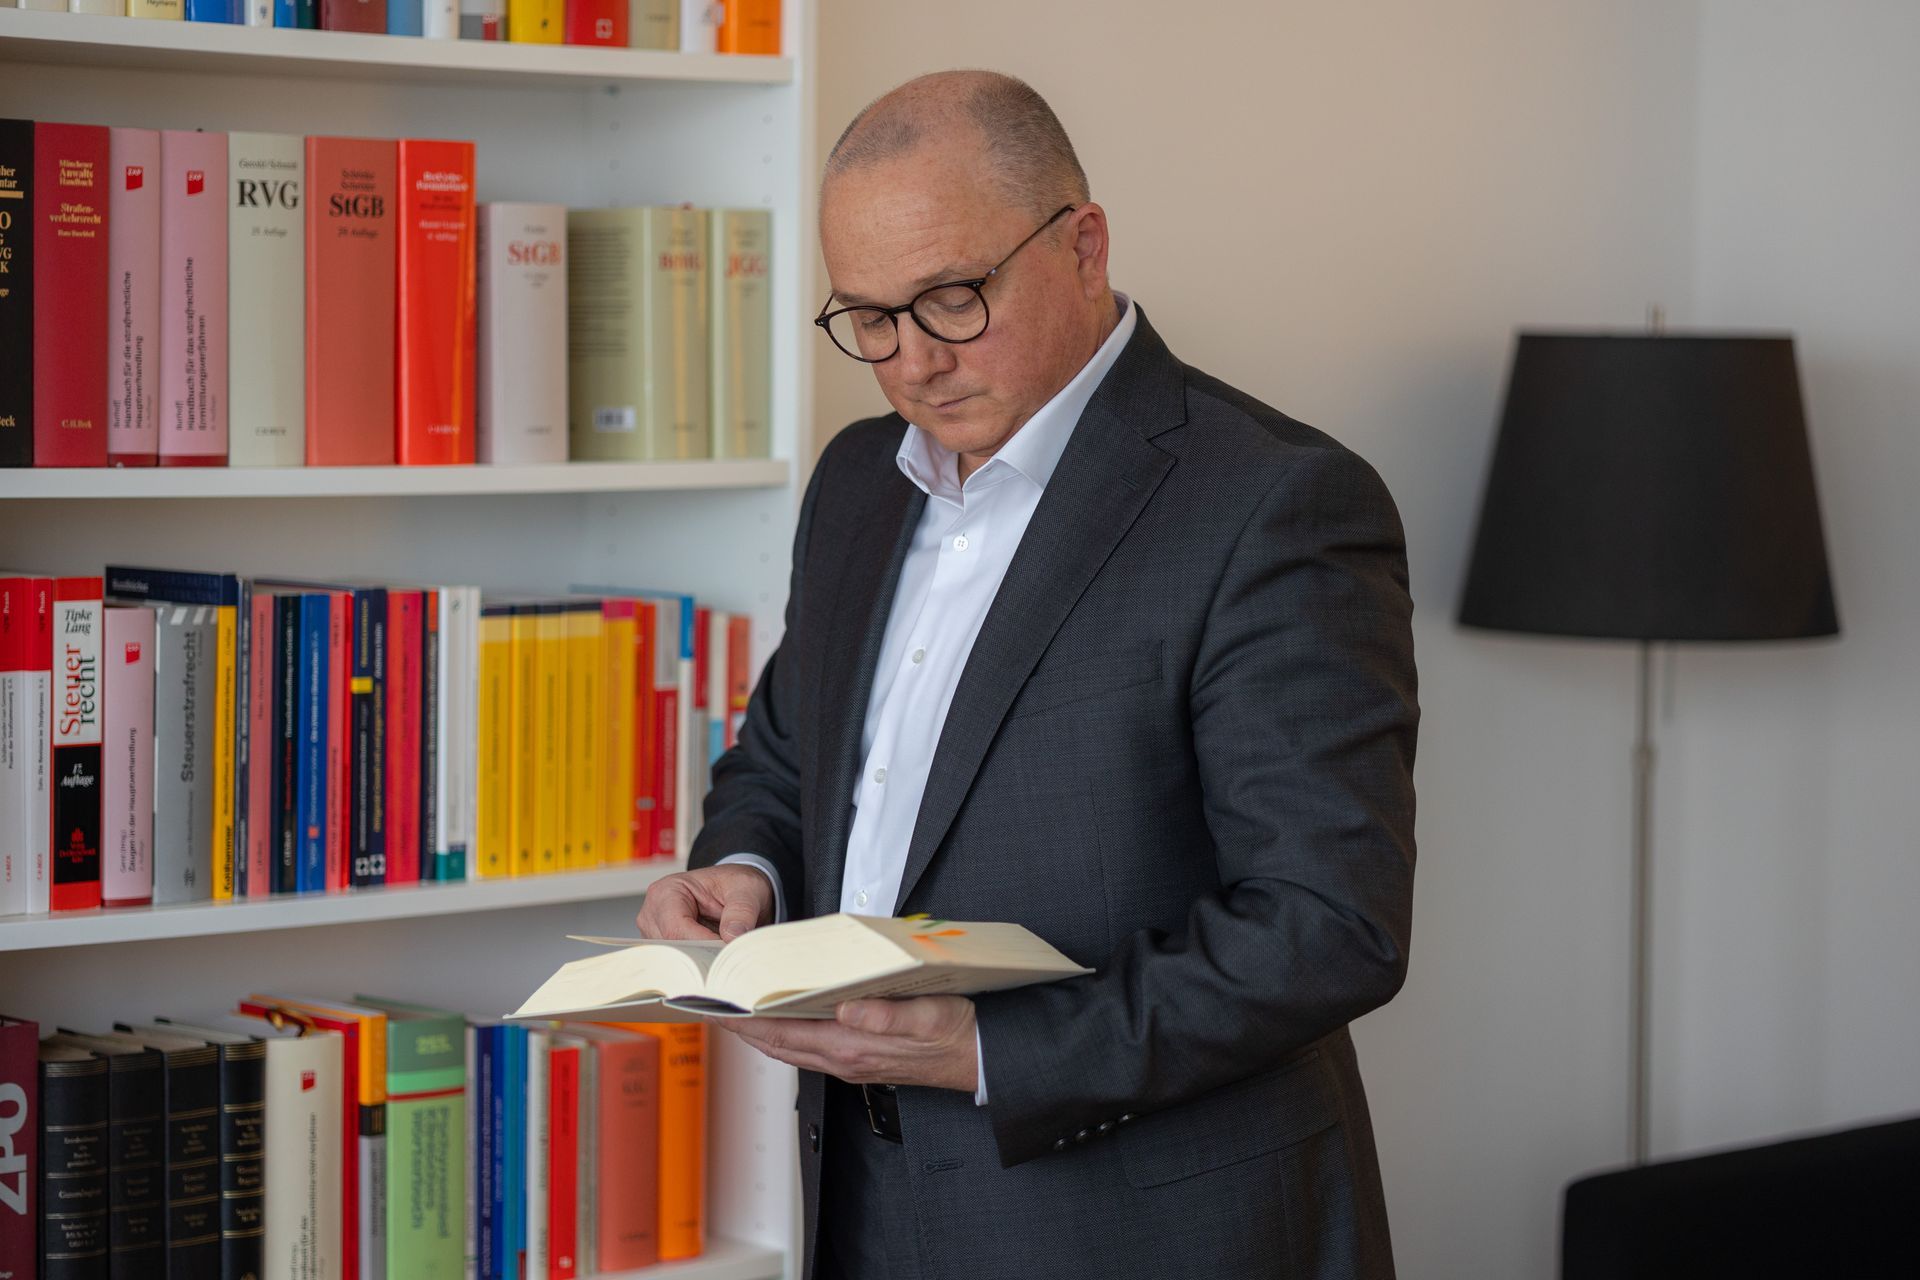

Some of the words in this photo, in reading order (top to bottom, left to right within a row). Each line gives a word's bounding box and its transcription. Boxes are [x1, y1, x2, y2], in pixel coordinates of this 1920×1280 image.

[236, 179, 299, 210] RVG
[328, 192, 385, 219] StGB
[507, 241, 563, 266] StGB
[123, 378, 132, 429] Handbuch
[186, 376, 195, 431] Handbuch
[65, 608, 93, 623] Tipke
[65, 621, 92, 635] Lang
[60, 643, 81, 736] Steuer
[75, 655, 95, 724] recht
[180, 631, 197, 782] Steuerstrafrecht
[60, 774, 95, 788] Auflage
